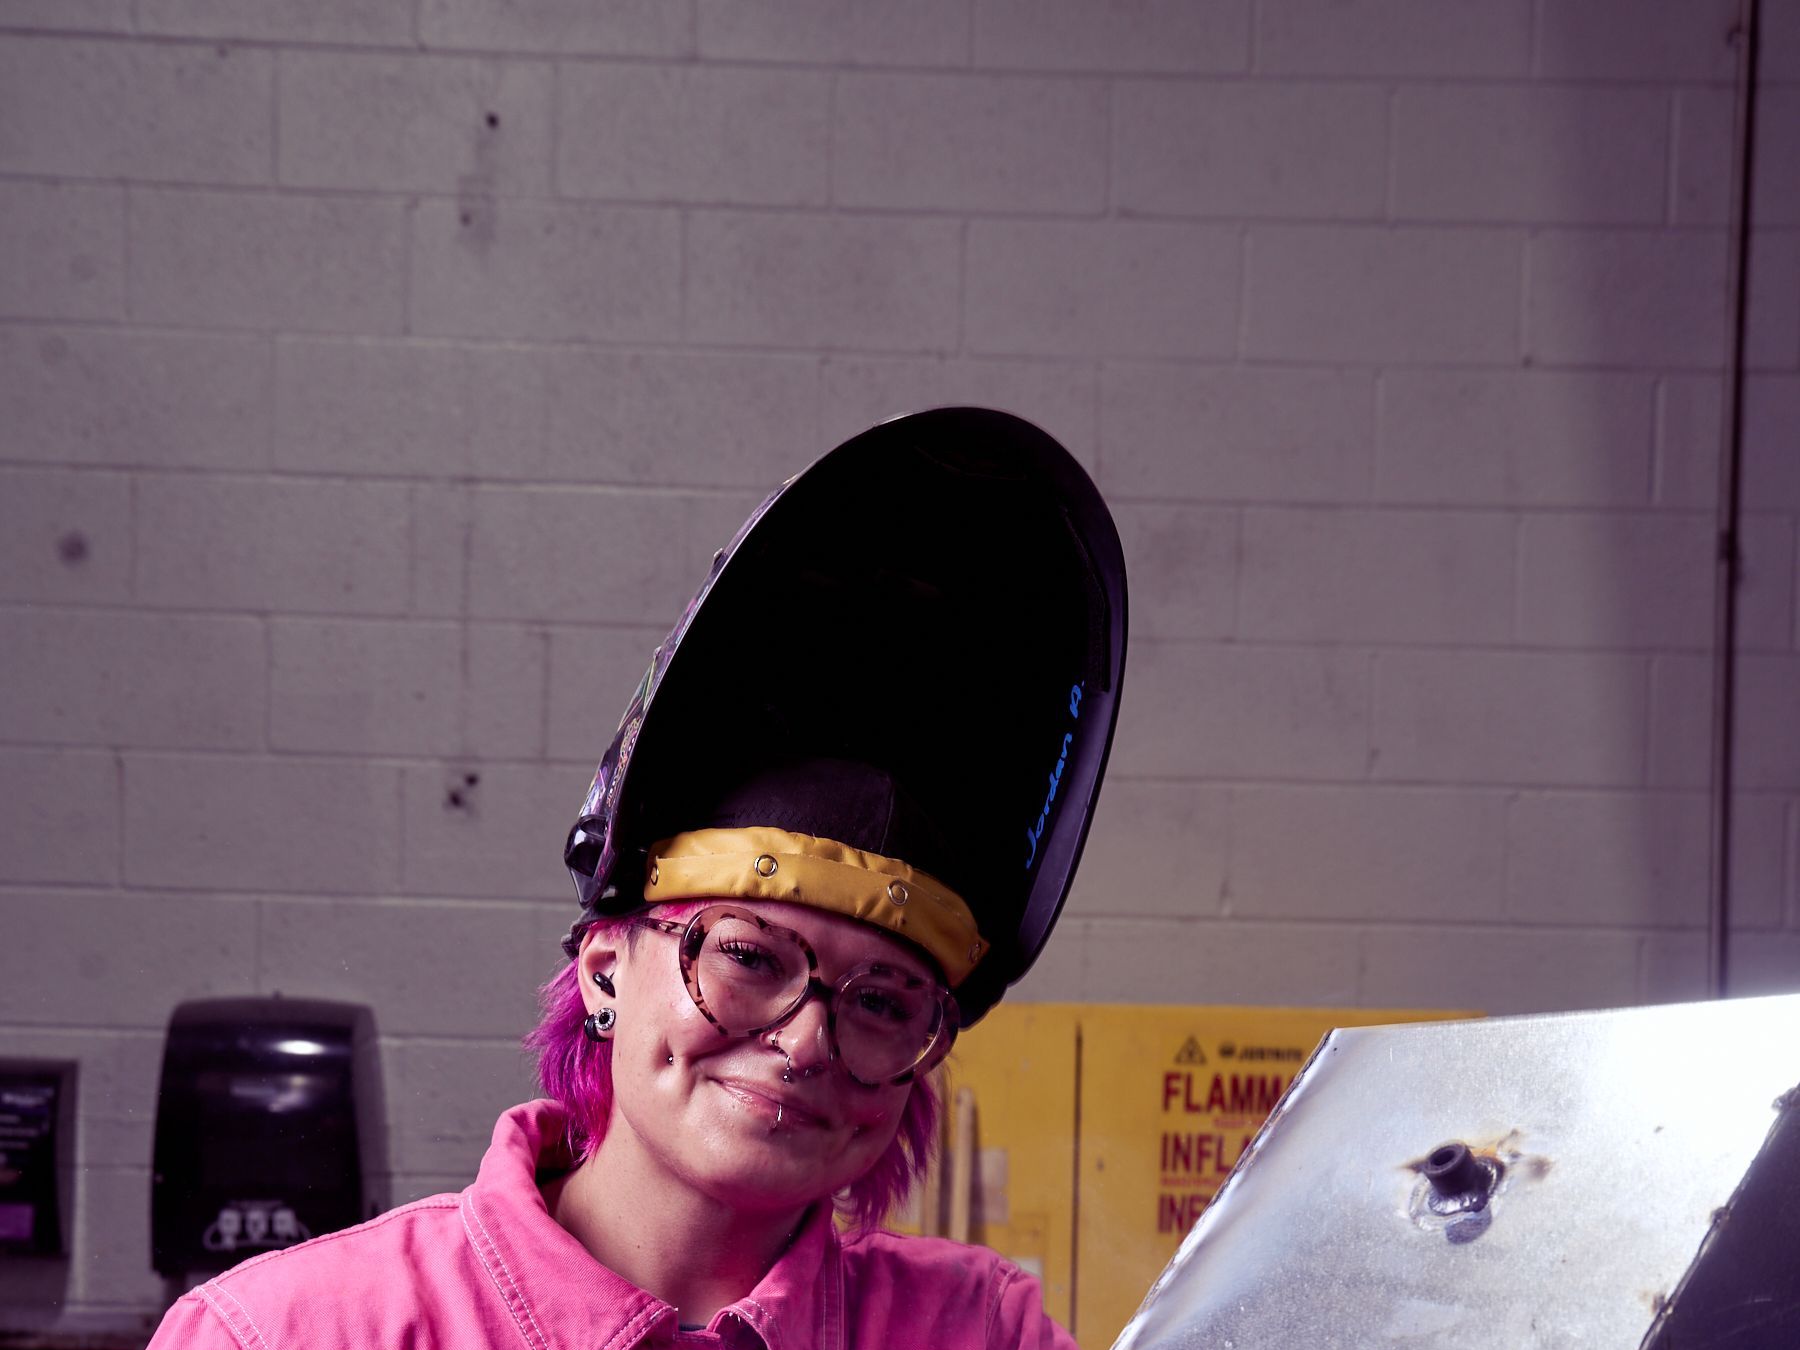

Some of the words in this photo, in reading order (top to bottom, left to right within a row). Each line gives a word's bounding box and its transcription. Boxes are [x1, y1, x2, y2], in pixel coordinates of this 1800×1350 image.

[1025, 732, 1073, 869] Jordan
[1162, 1071, 1297, 1114] FLAMM
[1160, 1132, 1252, 1174] INFL
[1158, 1193, 1212, 1234] INF
